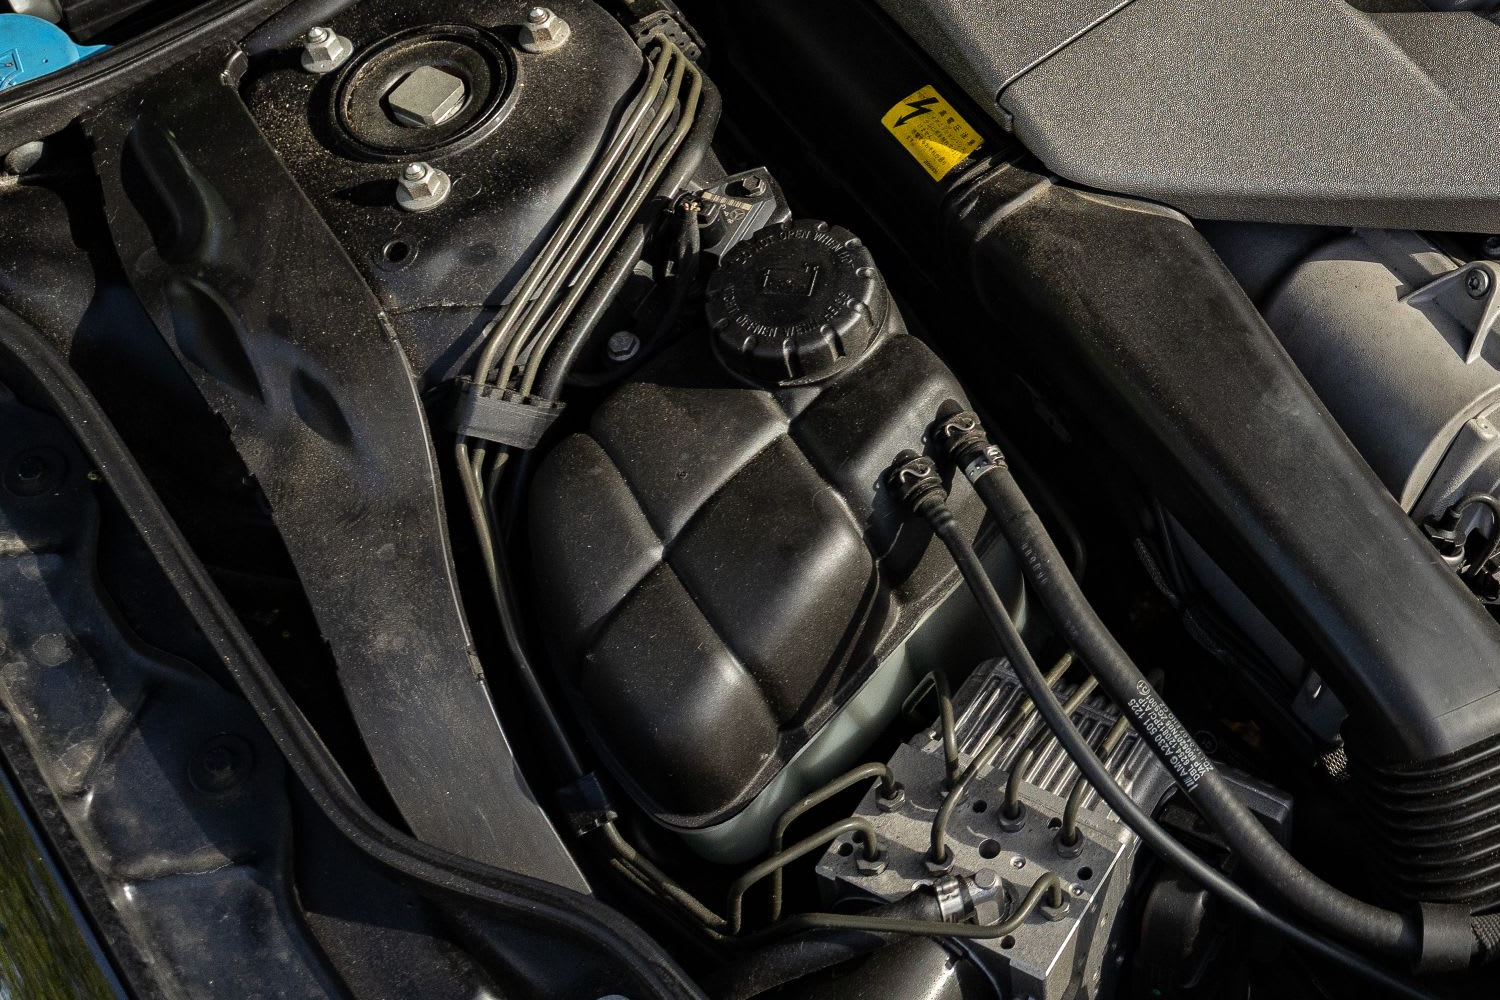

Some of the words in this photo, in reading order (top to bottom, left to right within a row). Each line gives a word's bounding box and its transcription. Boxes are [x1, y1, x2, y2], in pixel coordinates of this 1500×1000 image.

[1127, 698, 1146, 719] 1225
[1142, 720, 1157, 735] 501
[1154, 735, 1174, 756] A230
[1170, 756, 1188, 777] AMG
[1187, 765, 1201, 782] DBL
